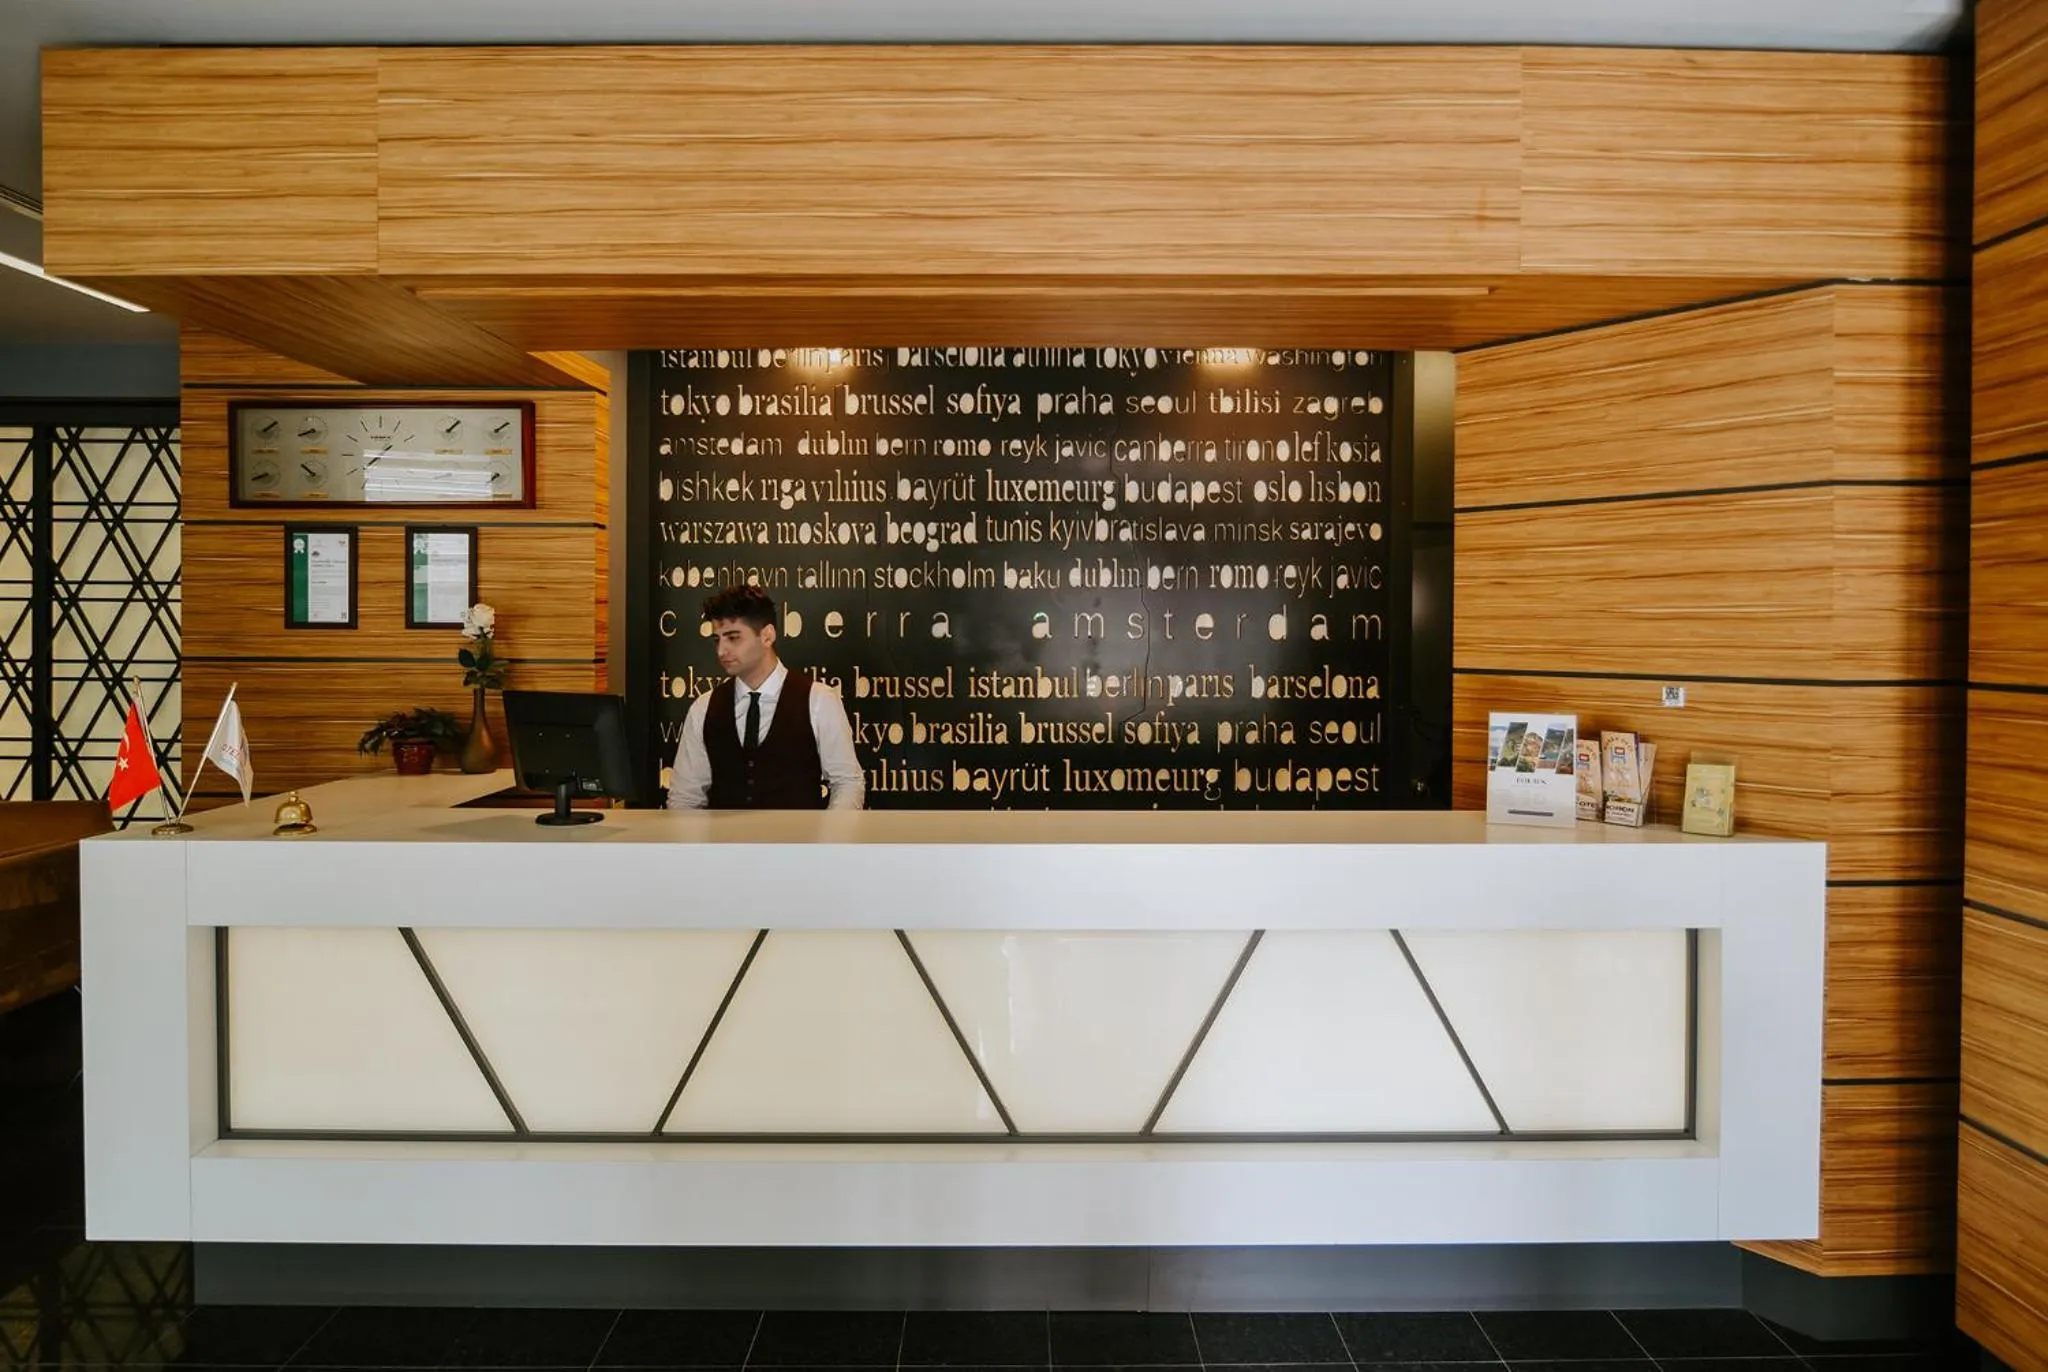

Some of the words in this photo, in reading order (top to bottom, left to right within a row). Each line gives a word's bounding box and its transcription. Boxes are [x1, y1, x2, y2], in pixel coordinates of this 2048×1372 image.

[661, 348, 752, 369] istanbul
[897, 347, 1005, 368] barselona
[1095, 347, 1157, 377] tokyo
[661, 384, 731, 423] tokyo
[737, 384, 832, 416] brasilia
[844, 384, 935, 416] brussel
[947, 383, 1021, 423] sofiya
[1037, 386, 1114, 423] praha
[1126, 391, 1197, 414] seoul
[1209, 388, 1281, 414] tbilisi
[1293, 390, 1383, 420] zagreb
[659, 431, 782, 456] amstedam
[797, 430, 869, 456] dublin
[876, 432, 927, 456] bern
[933, 438, 992, 456] romo
[1001, 434, 1048, 463] reyk
[1114, 432, 1217, 462] canberra
[659, 470, 755, 501] bishkek
[761, 478, 807, 510] riga
[897, 470, 976, 510] bayrüt
[1125, 473, 1243, 511] budapest
[1254, 470, 1303, 503] oslo
[1309, 470, 1381, 503] lisbon
[660, 521, 769, 544] warszawa
[777, 512, 877, 544] moskova
[885, 511, 978, 552] beograd
[986, 511, 1043, 543] tunis
[1050, 511, 1094, 550] kyiv
[1095, 511, 1206, 543] bratislava
[1214, 519, 1283, 542] minsk
[1289, 515, 1383, 546] sarajevo
[797, 560, 866, 589] tallinn
[874, 560, 995, 589] stockholm
[1004, 560, 1060, 589] baku
[1069, 558, 1139, 589] dublin
[1147, 558, 1198, 590] bern
[1209, 564, 1269, 589] romo
[659, 601, 952, 638] caberra
[1032, 604, 1382, 640] amsterdam
[853, 665, 954, 698] brussel
[968, 666, 1078, 698] istanbul
[1249, 664, 1380, 699] barselona
[911, 712, 1009, 744] brasilia
[1019, 712, 1114, 744] brussel
[1124, 711, 1200, 752] sofiya
[1217, 712, 1296, 753] praha
[1309, 712, 1381, 744] seoul
[953, 759, 1050, 800] bayrüt
[1235, 758, 1380, 800] budapest
